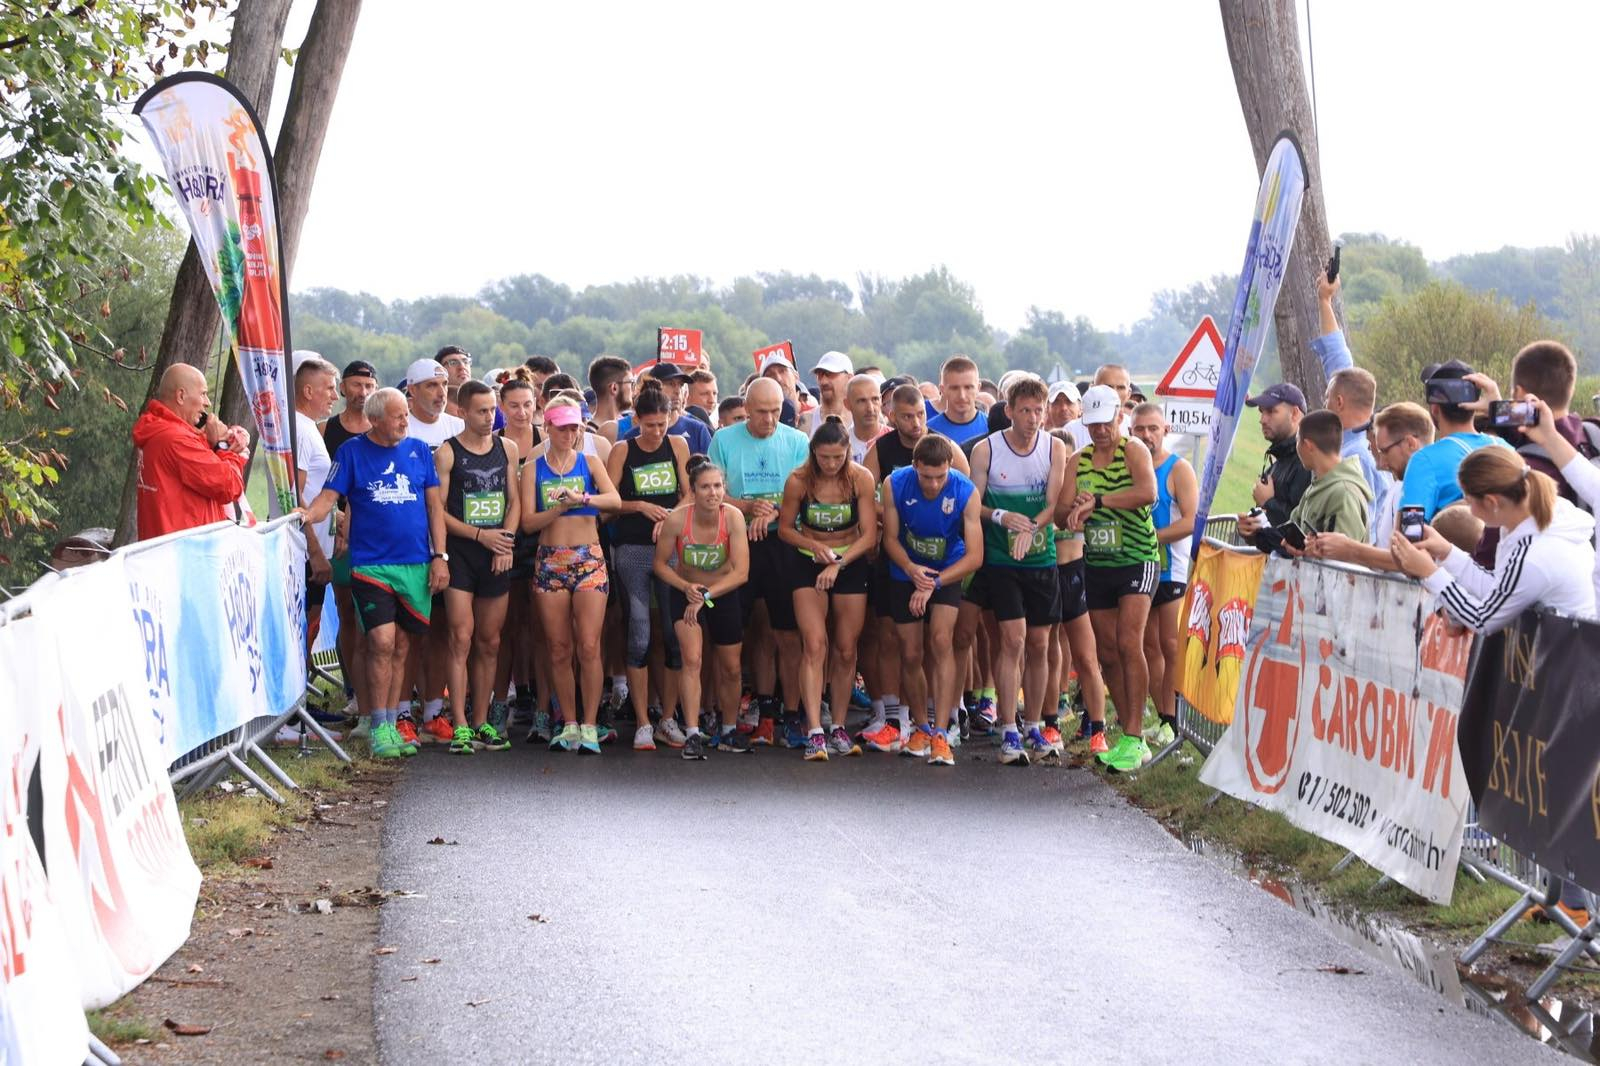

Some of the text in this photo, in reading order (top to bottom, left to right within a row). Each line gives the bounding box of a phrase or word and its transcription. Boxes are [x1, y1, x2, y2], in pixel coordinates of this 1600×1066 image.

[661, 333, 688, 351] 2:15
[1179, 410, 1200, 426] 10,5
[639, 471, 672, 489] 262
[470, 500, 501, 517] 253
[814, 512, 844, 525] 154
[1089, 528, 1116, 545] 291
[911, 537, 938, 556] 153
[691, 551, 721, 566] 172
[1347, 792, 1372, 828] 502
